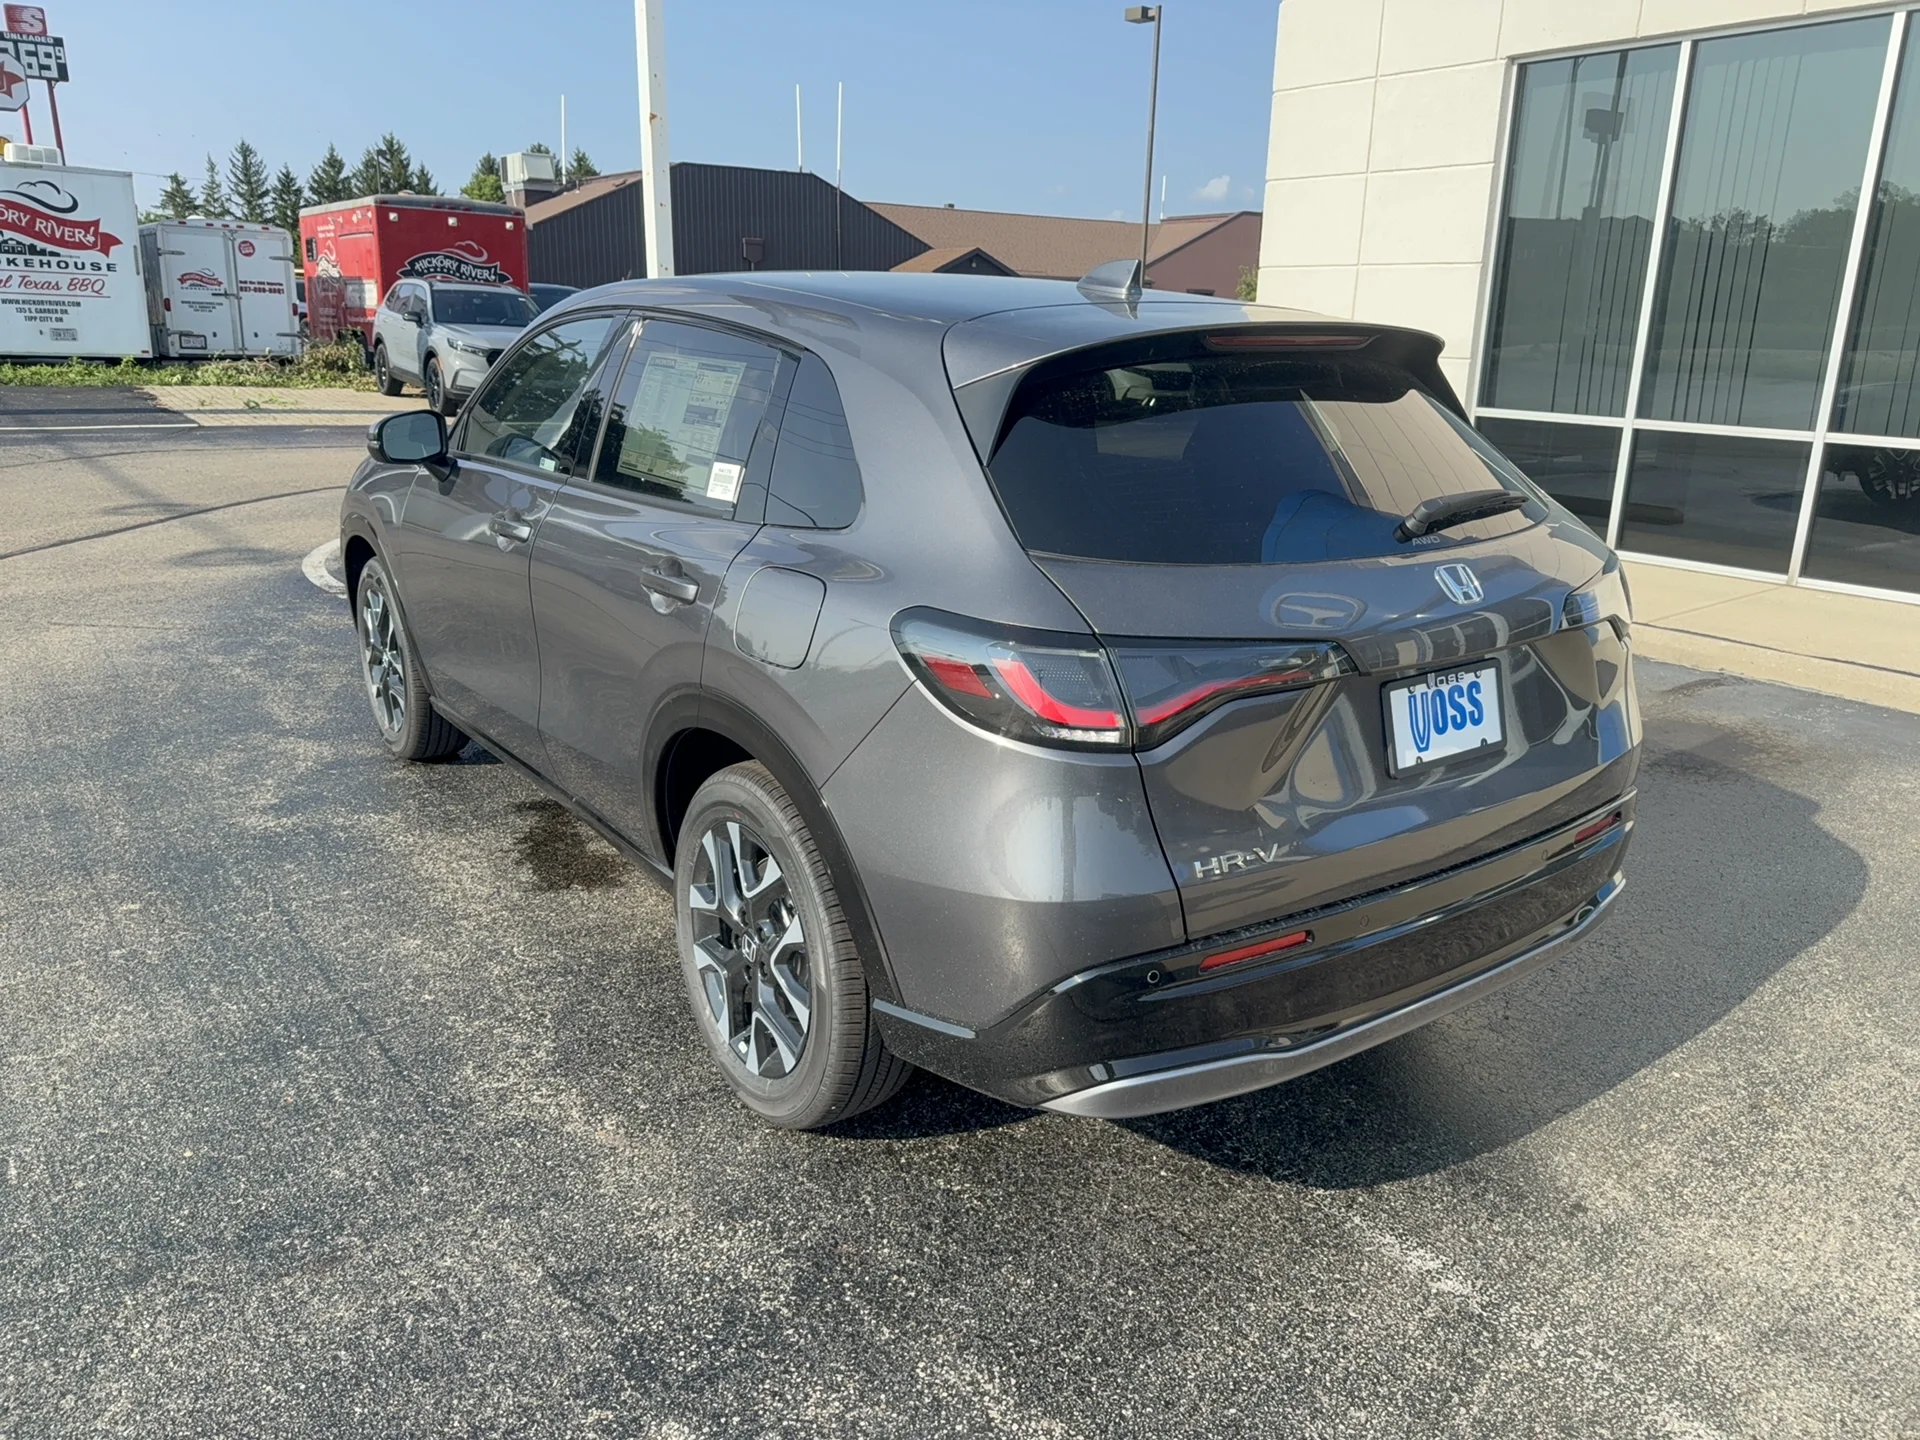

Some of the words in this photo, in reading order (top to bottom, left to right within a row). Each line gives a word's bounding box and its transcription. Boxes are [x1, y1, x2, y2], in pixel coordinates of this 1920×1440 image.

[3, 32, 54, 43] UNLEADED
[0, 205, 31, 226] ORY
[0, 257, 118, 272] KEHOUSE
[414, 255, 459, 272] HICKORY
[17, 274, 62, 291] Texas
[67, 277, 106, 295] BBQ
[1412, 535, 1441, 546] AWD
[1408, 680, 1484, 753] VOSS
[1193, 843, 1278, 878] HR-V
